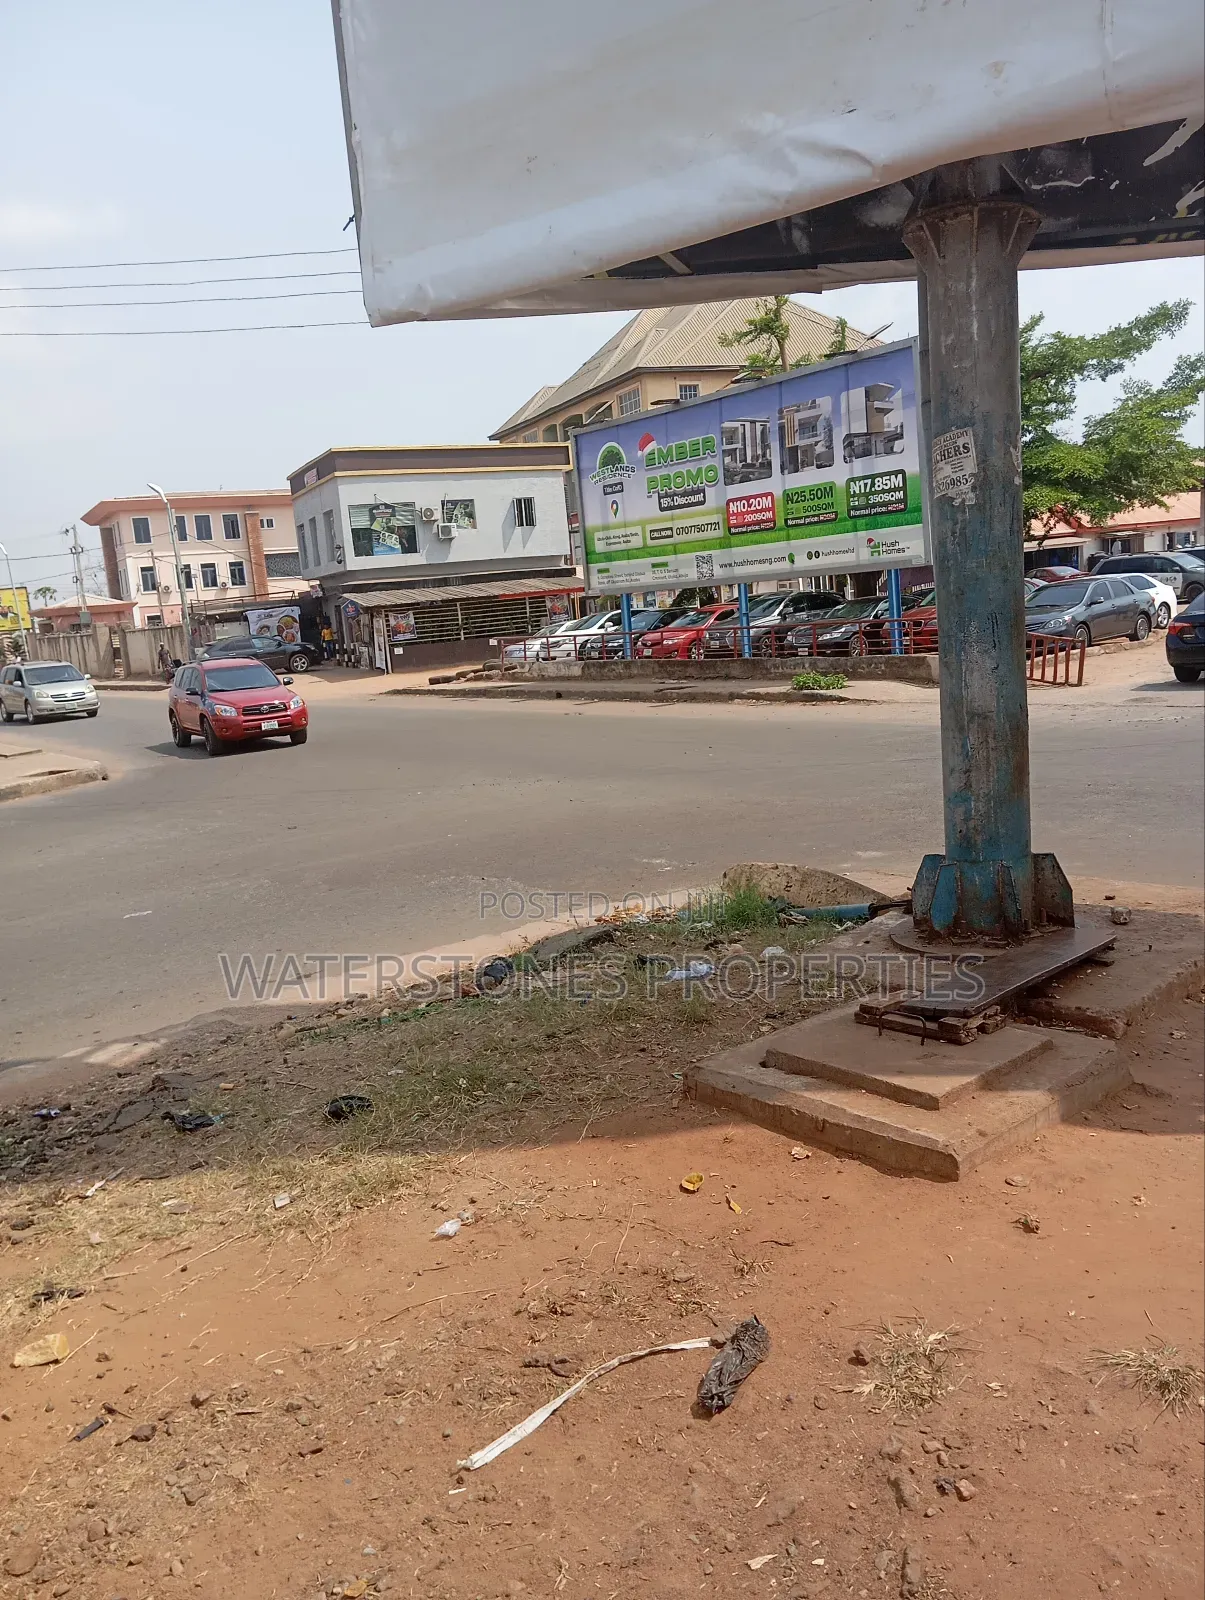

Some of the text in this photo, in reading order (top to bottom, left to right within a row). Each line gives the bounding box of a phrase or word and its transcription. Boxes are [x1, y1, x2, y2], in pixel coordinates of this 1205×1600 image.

[943, 430, 969, 442] ACADEMY
[645, 435, 716, 468] EMBER
[589, 465, 636, 481] WESTLANDS
[594, 472, 632, 485] RESIDENCE
[646, 464, 719, 495] PROMO
[660, 492, 705, 508] 15% Discount
[868, 490, 904, 504] 350SQM
[802, 502, 835, 513] 500SQM
[850, 508, 871, 517] Normal
[870, 506, 888, 515] price:
[743, 511, 773, 522] 200SQM
[787, 516, 805, 526] Normal
[805, 514, 820, 524] price:
[675, 521, 721, 536] 07077507721
[730, 525, 747, 534] Normal
[747, 524, 761, 532] price:
[881, 540, 900, 549] Hush
[881, 547, 906, 556] Homes
[718, 555, 787, 569] www.hushhomesng.com
